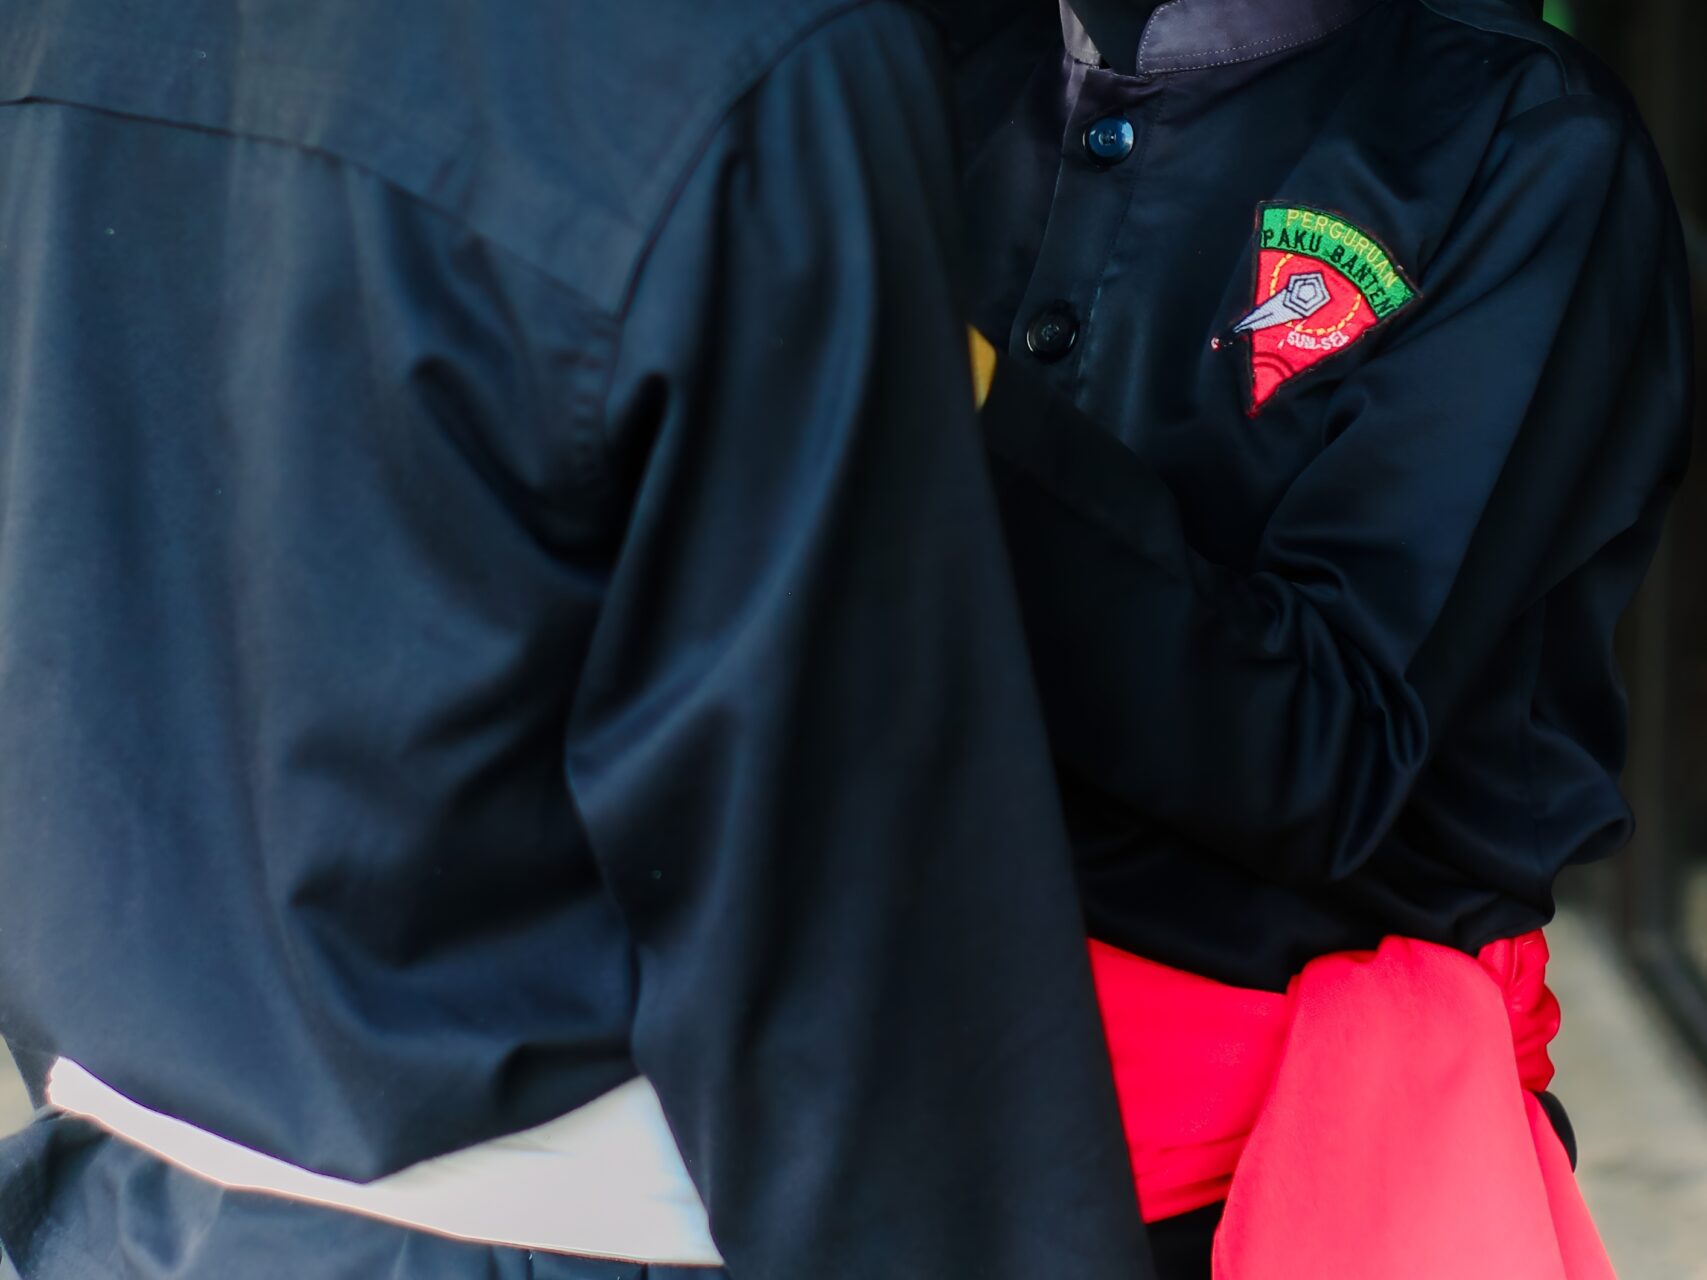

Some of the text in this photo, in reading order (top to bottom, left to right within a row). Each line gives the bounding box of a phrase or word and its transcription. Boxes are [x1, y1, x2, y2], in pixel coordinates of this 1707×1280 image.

[1262, 228, 1396, 320] PAKU BANTEN
[1286, 208, 1400, 288] PERGURUAN
